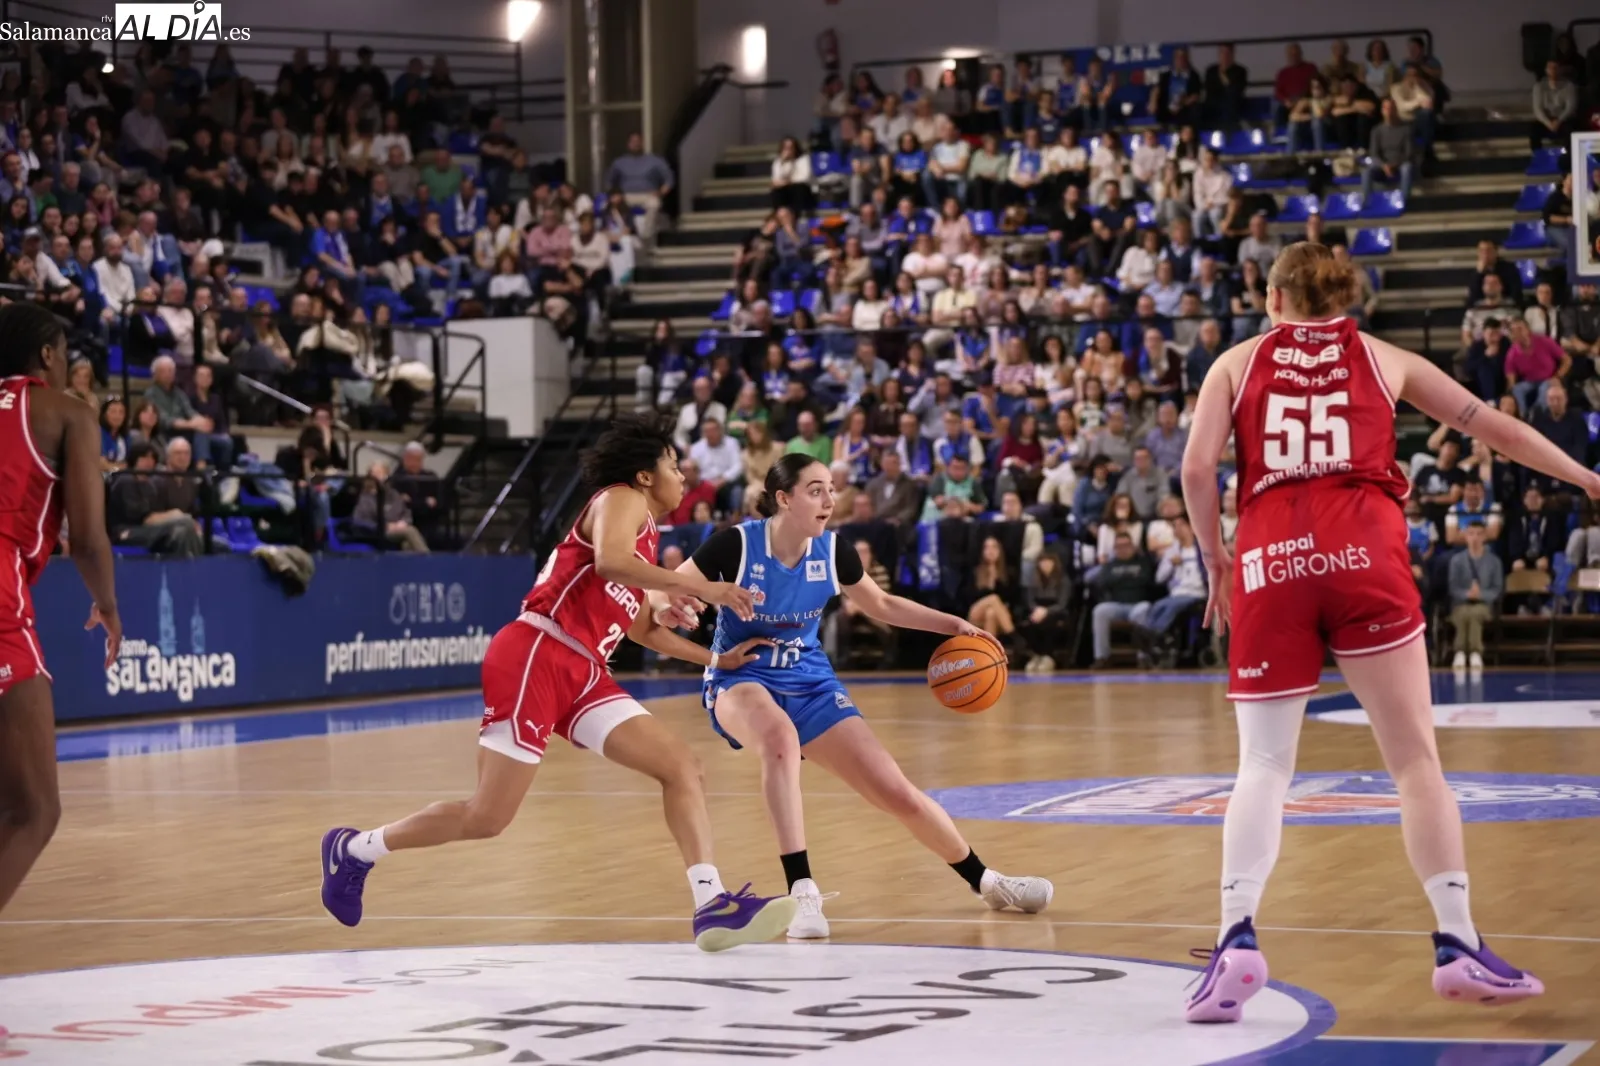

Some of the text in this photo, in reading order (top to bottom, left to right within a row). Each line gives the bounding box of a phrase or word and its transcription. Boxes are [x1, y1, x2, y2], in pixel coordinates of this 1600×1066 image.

[1263, 390, 1351, 472] 55
[1267, 533, 1314, 556] espai
[1268, 544, 1371, 583] GIRONÈS
[604, 580, 641, 621] GIRO
[754, 612, 788, 622] STILLA
[793, 612, 800, 622] Y
[597, 622, 626, 662] 2
[540, 966, 1128, 1066] CASTIL
